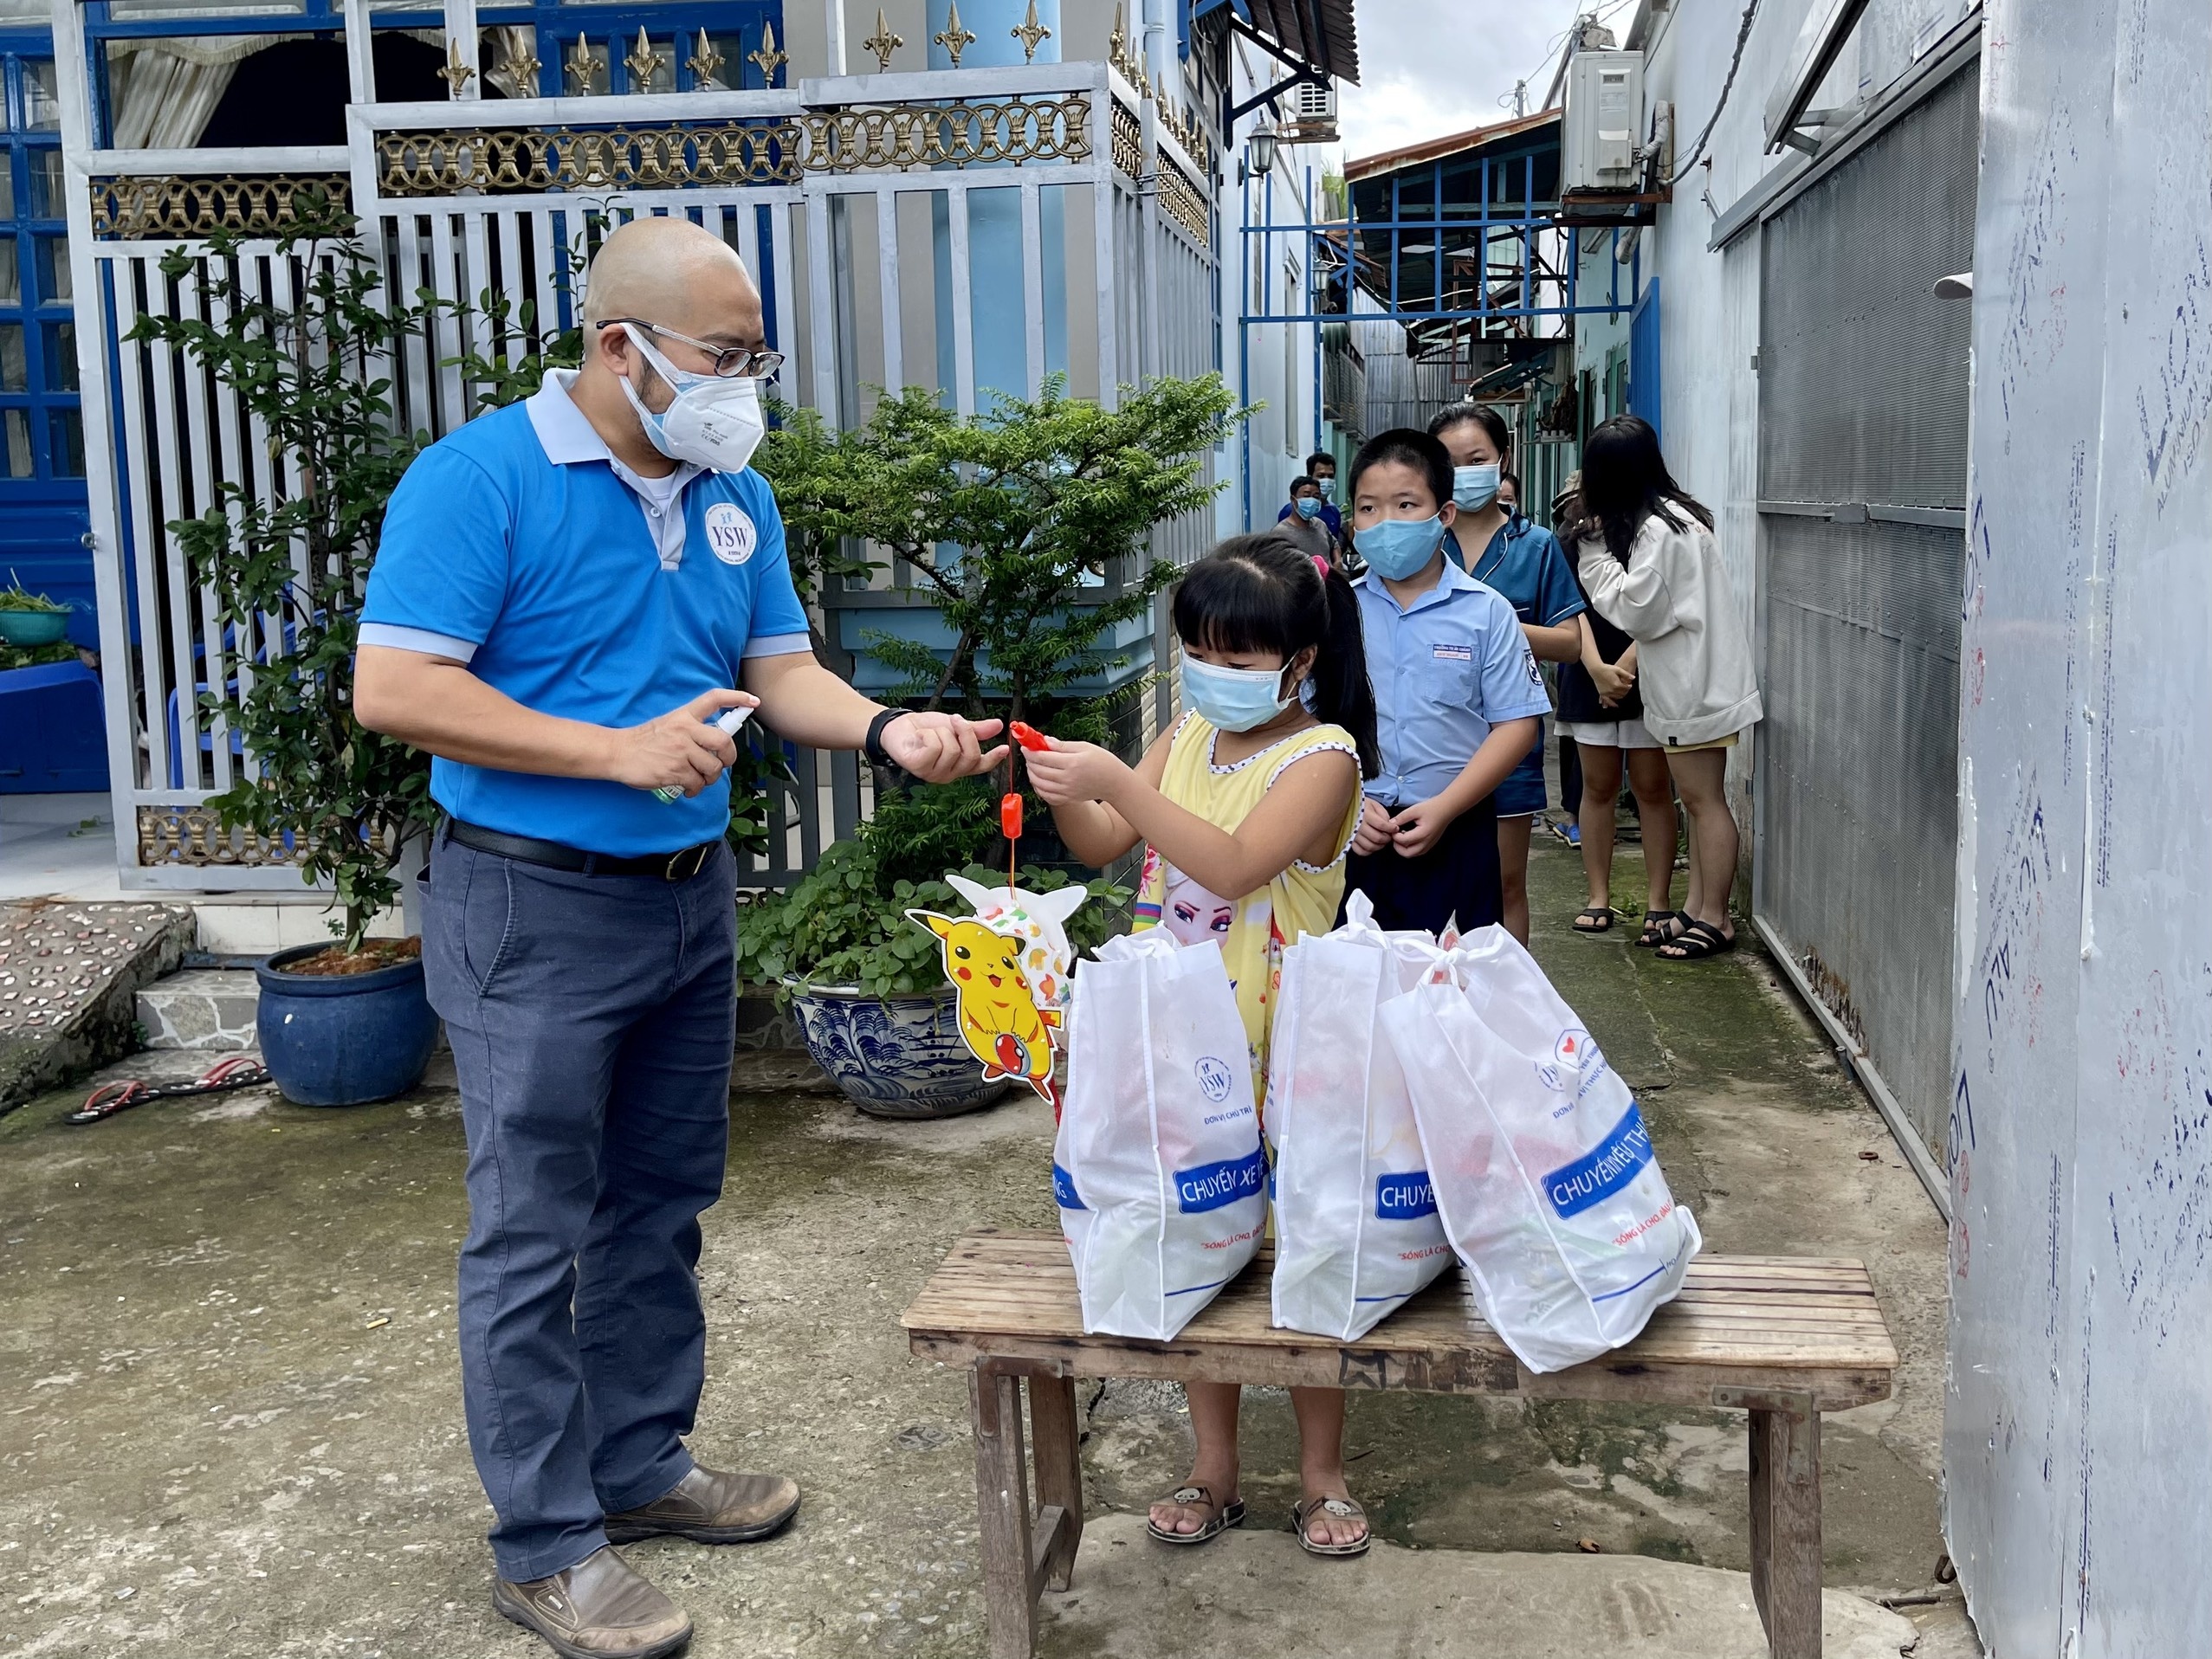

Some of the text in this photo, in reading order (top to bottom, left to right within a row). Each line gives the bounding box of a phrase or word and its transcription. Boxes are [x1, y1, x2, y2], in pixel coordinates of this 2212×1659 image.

[711, 526, 747, 548] YSW
[1200, 1072, 1225, 1092] YSW
[1182, 1166, 1237, 1203] CHUYẾN
